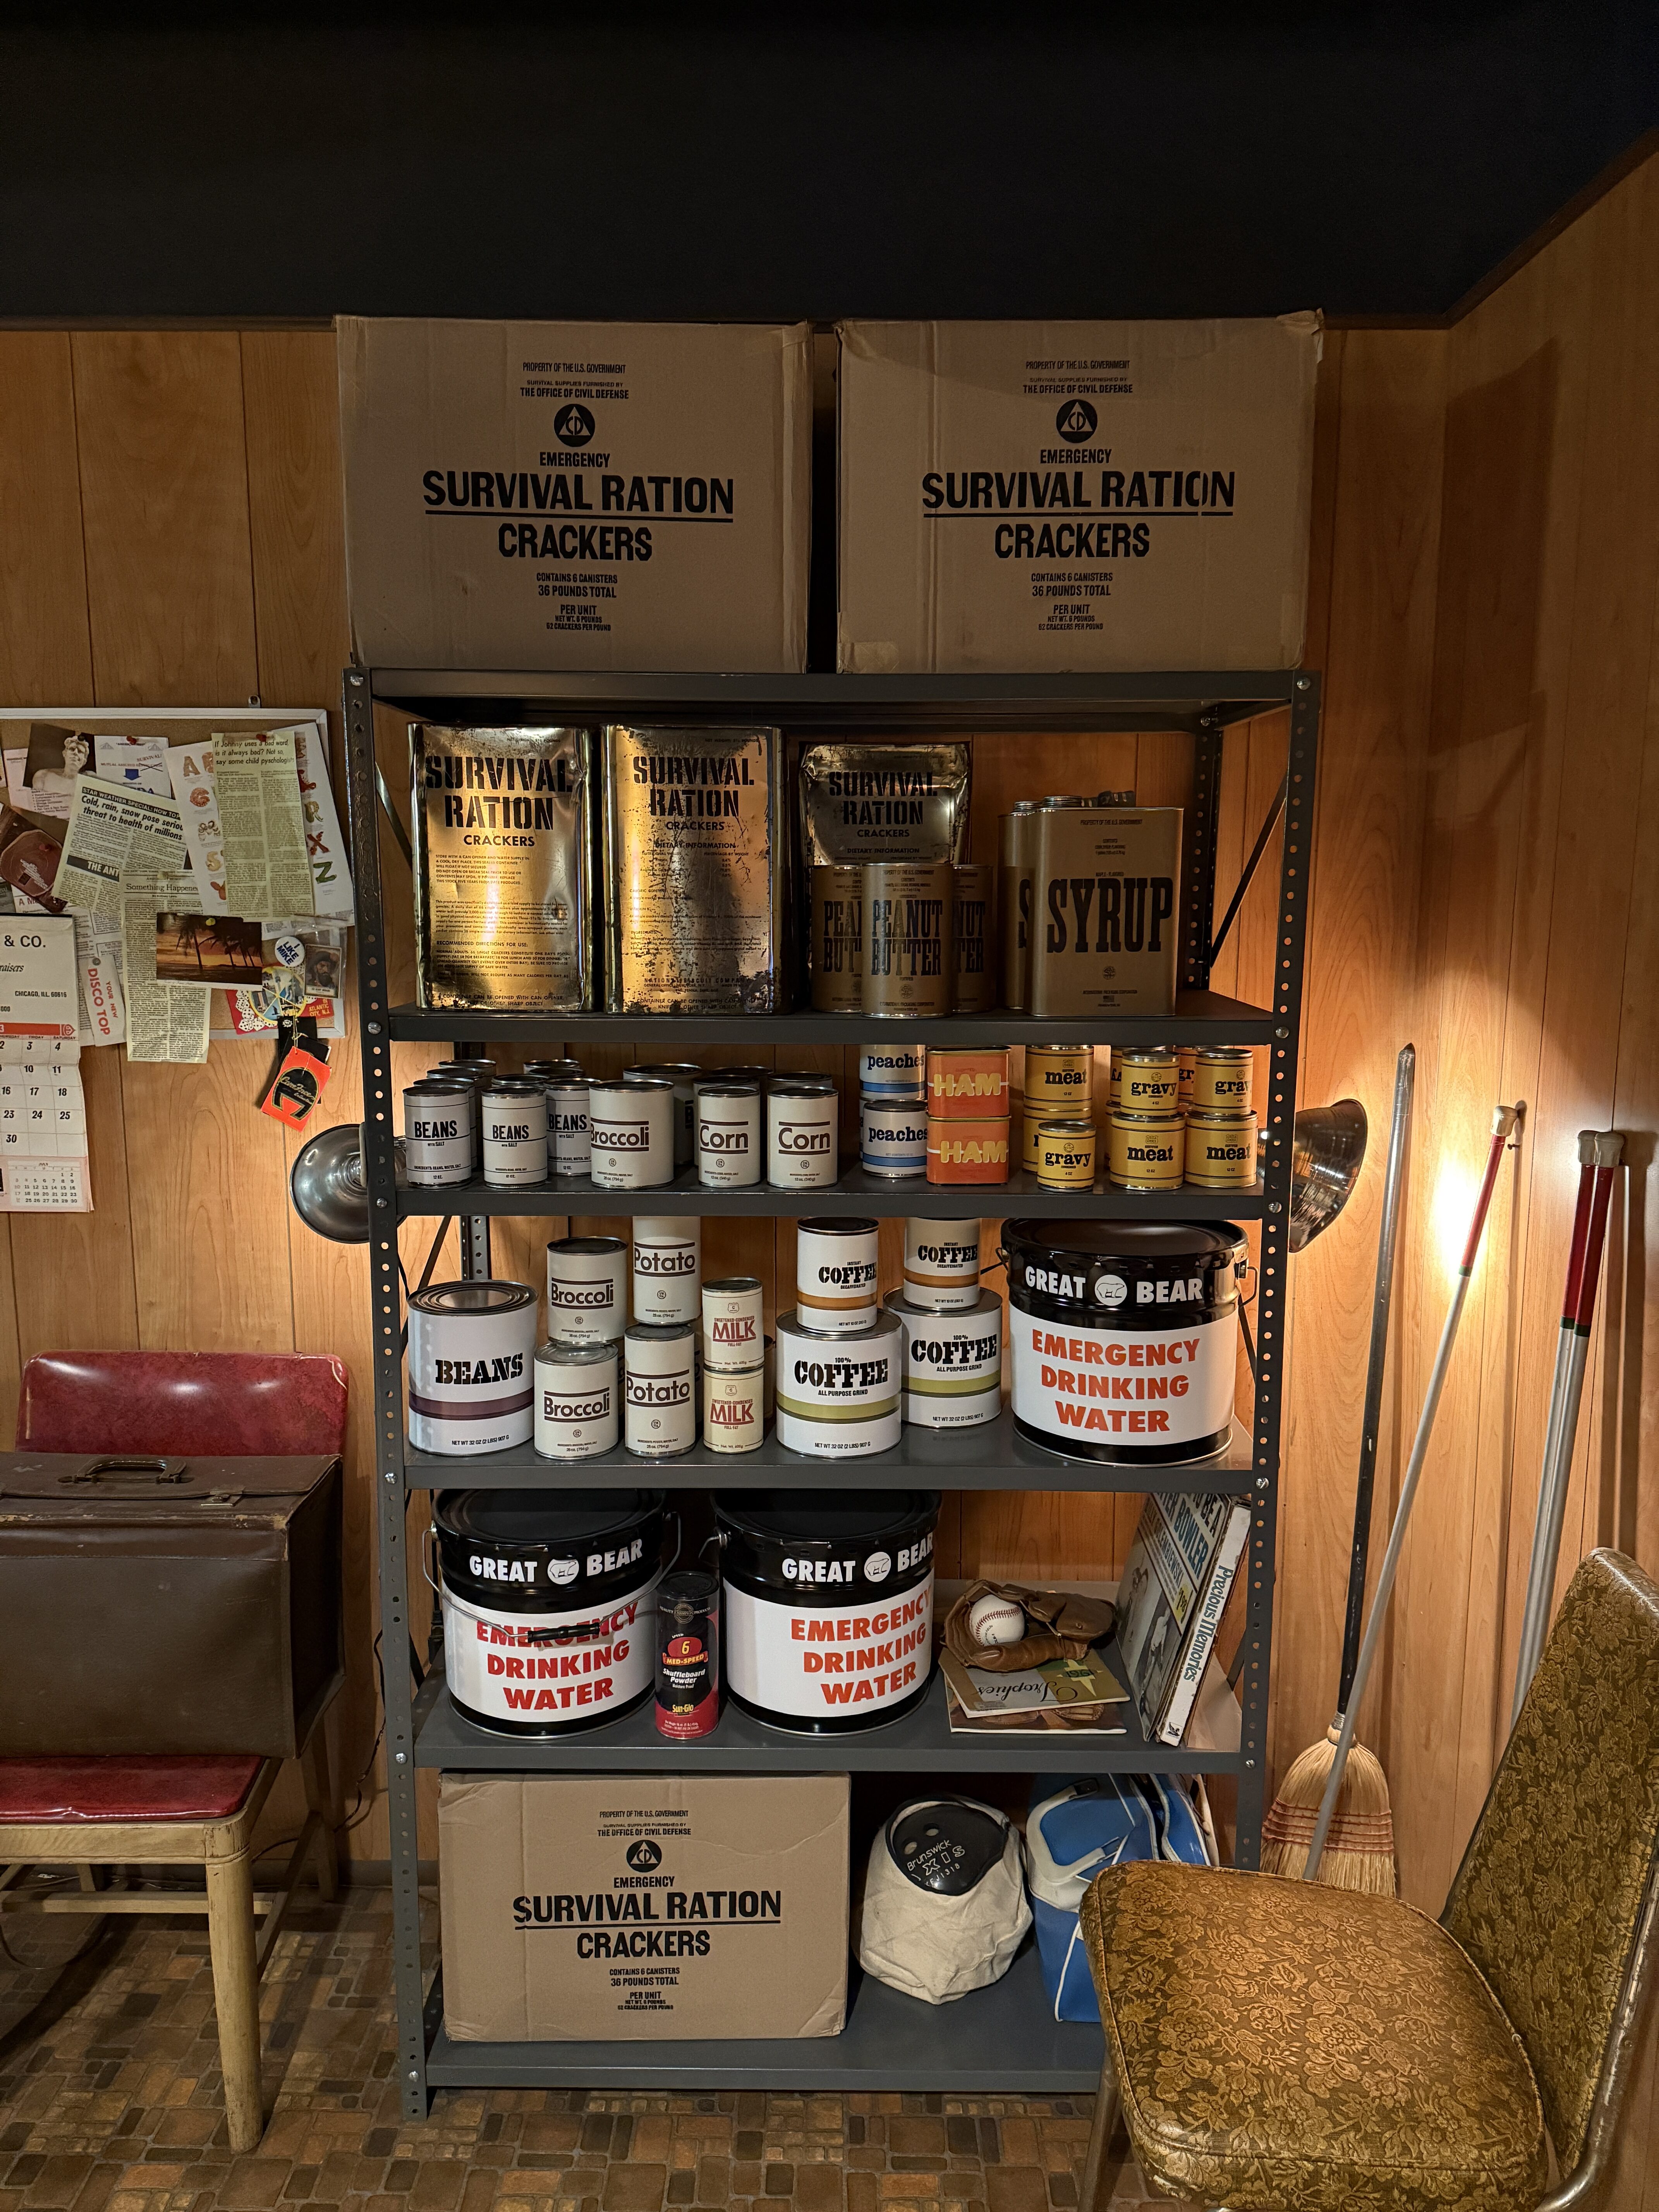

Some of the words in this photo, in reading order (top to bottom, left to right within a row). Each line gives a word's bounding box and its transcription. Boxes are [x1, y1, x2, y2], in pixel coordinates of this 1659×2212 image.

[523, 362, 552, 372] PROPERTY
[554, 363, 561, 372] OF
[563, 363, 574, 372] THE
[575, 364, 586, 373] U.S.
[587, 364, 625, 374] GOVERNMENT
[520, 387, 535, 397] THE
[537, 388, 562, 397] OFFICE
[564, 388, 573, 397] OF
[575, 388, 594, 398] CIVIL
[596, 389, 629, 399] DEFENSE
[540, 452, 610, 467] EMERGENCY
[1040, 449, 1111, 464] EMERGENCY
[423, 470, 592, 510] SURVIVAL
[602, 475, 733, 514] RATION
[923, 472, 1091, 508] SURVIVAL
[1101, 471, 1235, 508] RATION
[498, 523, 652, 561] CRACKERS
[995, 523, 1150, 558] CRACKERS
[1031, 573, 1066, 582] CONTAINS
[1068, 573, 1072, 581] 6
[1074, 573, 1113, 581] CANISTERS
[538, 585, 550, 596] 36
[552, 586, 588, 597] POUNDS
[589, 586, 617, 598] TOTAL
[561, 605, 575, 615] PER
[578, 605, 597, 615] UNIT
[426, 756, 573, 792] SURVIVAL
[634, 756, 754, 786] SURVIVAL
[829, 772, 938, 797] SURVIVAL
[82, 795, 99, 807] Cold,
[102, 802, 118, 812] rain,
[121, 808, 140, 818] snow
[142, 814, 160, 823] pose
[445, 795, 554, 830] RATION
[650, 789, 739, 817] RATION
[843, 801, 923, 824] RATION
[84, 807, 107, 818] threat
[119, 817, 142, 829] health
[155, 828, 182, 840] millions
[666, 821, 725, 831] CRACKERS
[857, 829, 910, 838] CRACKERS
[464, 835, 534, 847] CRACKERS
[88, 861, 103, 871] THE
[872, 900, 943, 938] PEANUT
[1047, 878, 1173, 953] SYRUP
[4, 935, 15, 946] &
[21, 936, 46, 948] CO.
[283, 941, 299, 960] LIKE
[277, 945, 294, 965] MIKE
[871, 938, 941, 976] BUTTER
[88, 969, 103, 1006] DISCO
[97, 1010, 110, 1035] TOP
[867, 1054, 924, 1070] peaches
[933, 1073, 1001, 1096] HAM
[1045, 1070, 1087, 1085] meat
[1131, 1082, 1177, 1096] gravy
[30, 1087, 39, 1096] 17
[414, 1120, 457, 1138] BEANS
[493, 1125, 529, 1140] BEANS
[548, 1114, 587, 1130] BEANS
[591, 1125, 649, 1146] Broccoli
[700, 1125, 748, 1149] Corn
[778, 1127, 830, 1149] Corn
[940, 1140, 1006, 1163] HAM
[1045, 1153, 1091, 1166] gravy
[1127, 1145, 1173, 1162] meat
[1207, 1144, 1251, 1161] meat
[634, 1247, 695, 1272] Potato
[918, 1244, 977, 1263] COFFEE
[551, 1283, 614, 1304] Broccoli
[1026, 1266, 1085, 1298] GREAT
[1137, 1279, 1202, 1303] BEAR
[713, 1320, 756, 1339] MILK
[911, 1334, 997, 1364] COFFEE
[1032, 1329, 1200, 1366] EMERGENCY
[435, 1353, 523, 1385] BEANS
[794, 1358, 888, 1388] COFFEE
[627, 1376, 690, 1401] Potato
[1042, 1364, 1189, 1400] DRINKING
[544, 1394, 610, 1417] Broccoli
[710, 1403, 754, 1422] MILK
[1055, 1400, 1170, 1432] WATER
[1174, 1497, 1209, 1580] BOWLER
[470, 1555, 537, 1582] GREAT
[587, 1539, 642, 1577] BEAR
[782, 1558, 855, 1582] GREAT
[898, 1532, 933, 1571] BEAR
[1204, 1565, 1234, 1618] Precious
[791, 1588, 931, 1642] EMERGENCY
[487, 1639, 630, 1679] DRINKING
[666, 1654, 704, 1664] MED-SPEED
[682, 1641, 690, 1654] 6
[804, 1623, 926, 1673] DRINKING
[1183, 1619, 1217, 1682] Memories
[663, 1668, 706, 1678] Shuffleboard
[821, 1661, 916, 1704] WATER
[503, 1677, 613, 1710] WATER
[979, 1681, 1078, 1702] Trophies
[907, 1840, 951, 1871] Brunswick
[614, 1876, 674, 1888] EMERGENCY
[514, 1893, 659, 1922] SURVIVAL
[667, 1891, 781, 1919] RATION
[577, 1930, 710, 1959] CRACKERS
